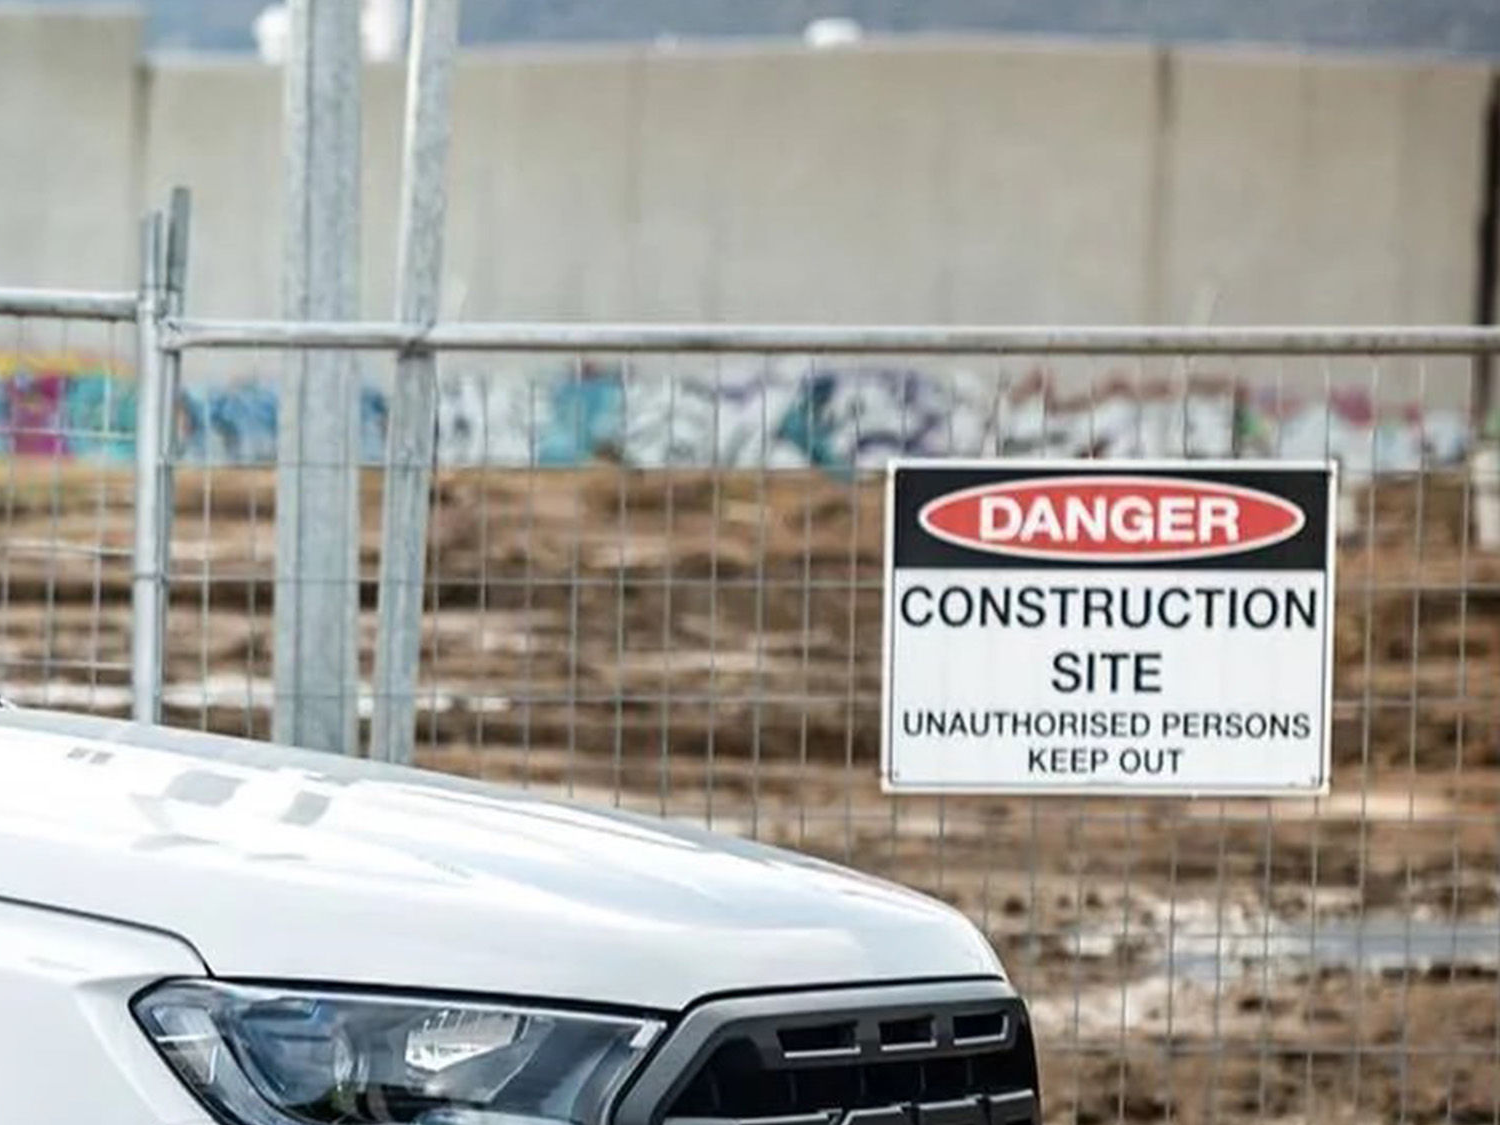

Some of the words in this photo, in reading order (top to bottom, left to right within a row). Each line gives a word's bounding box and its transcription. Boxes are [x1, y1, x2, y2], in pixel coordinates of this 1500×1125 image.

[977, 495, 1240, 543] DANGER
[900, 585, 1317, 629] CONSTRUCTION
[1051, 651, 1163, 694] SITE
[903, 710, 1151, 738] UNAUTHORISED
[1161, 711, 1311, 738] PERSONS
[1027, 748, 1109, 774] KEEP
[1118, 747, 1185, 774] OUT
